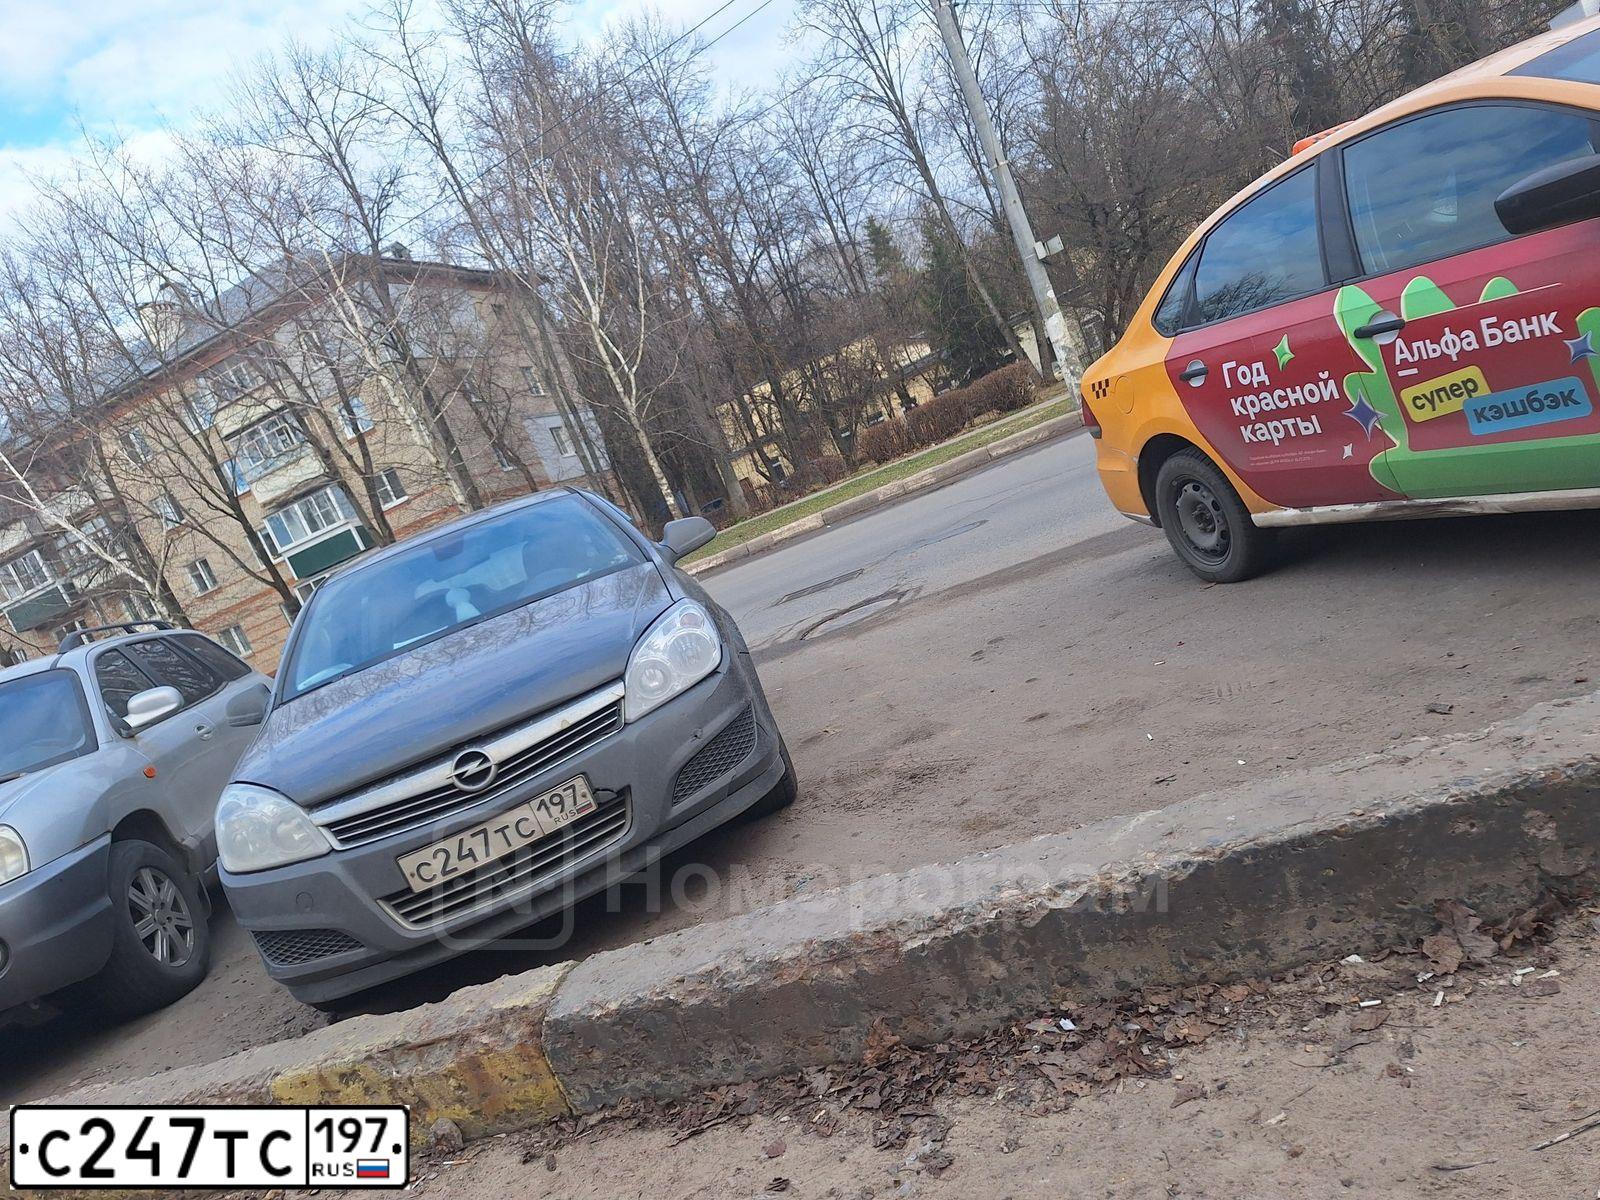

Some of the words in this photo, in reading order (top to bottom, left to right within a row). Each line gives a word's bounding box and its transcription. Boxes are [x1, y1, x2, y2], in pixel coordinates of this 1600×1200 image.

[1394, 327, 1479, 366] Альфа
[1480, 311, 1563, 348] Банк
[1222, 359, 1269, 388] Год
[1230, 370, 1340, 419] красной
[1411, 375, 1480, 413] супер
[1472, 387, 1581, 424] кэшбэк
[1240, 415, 1322, 446] карты
[536, 784, 579, 819] 197
[553, 809, 577, 825] RUS
